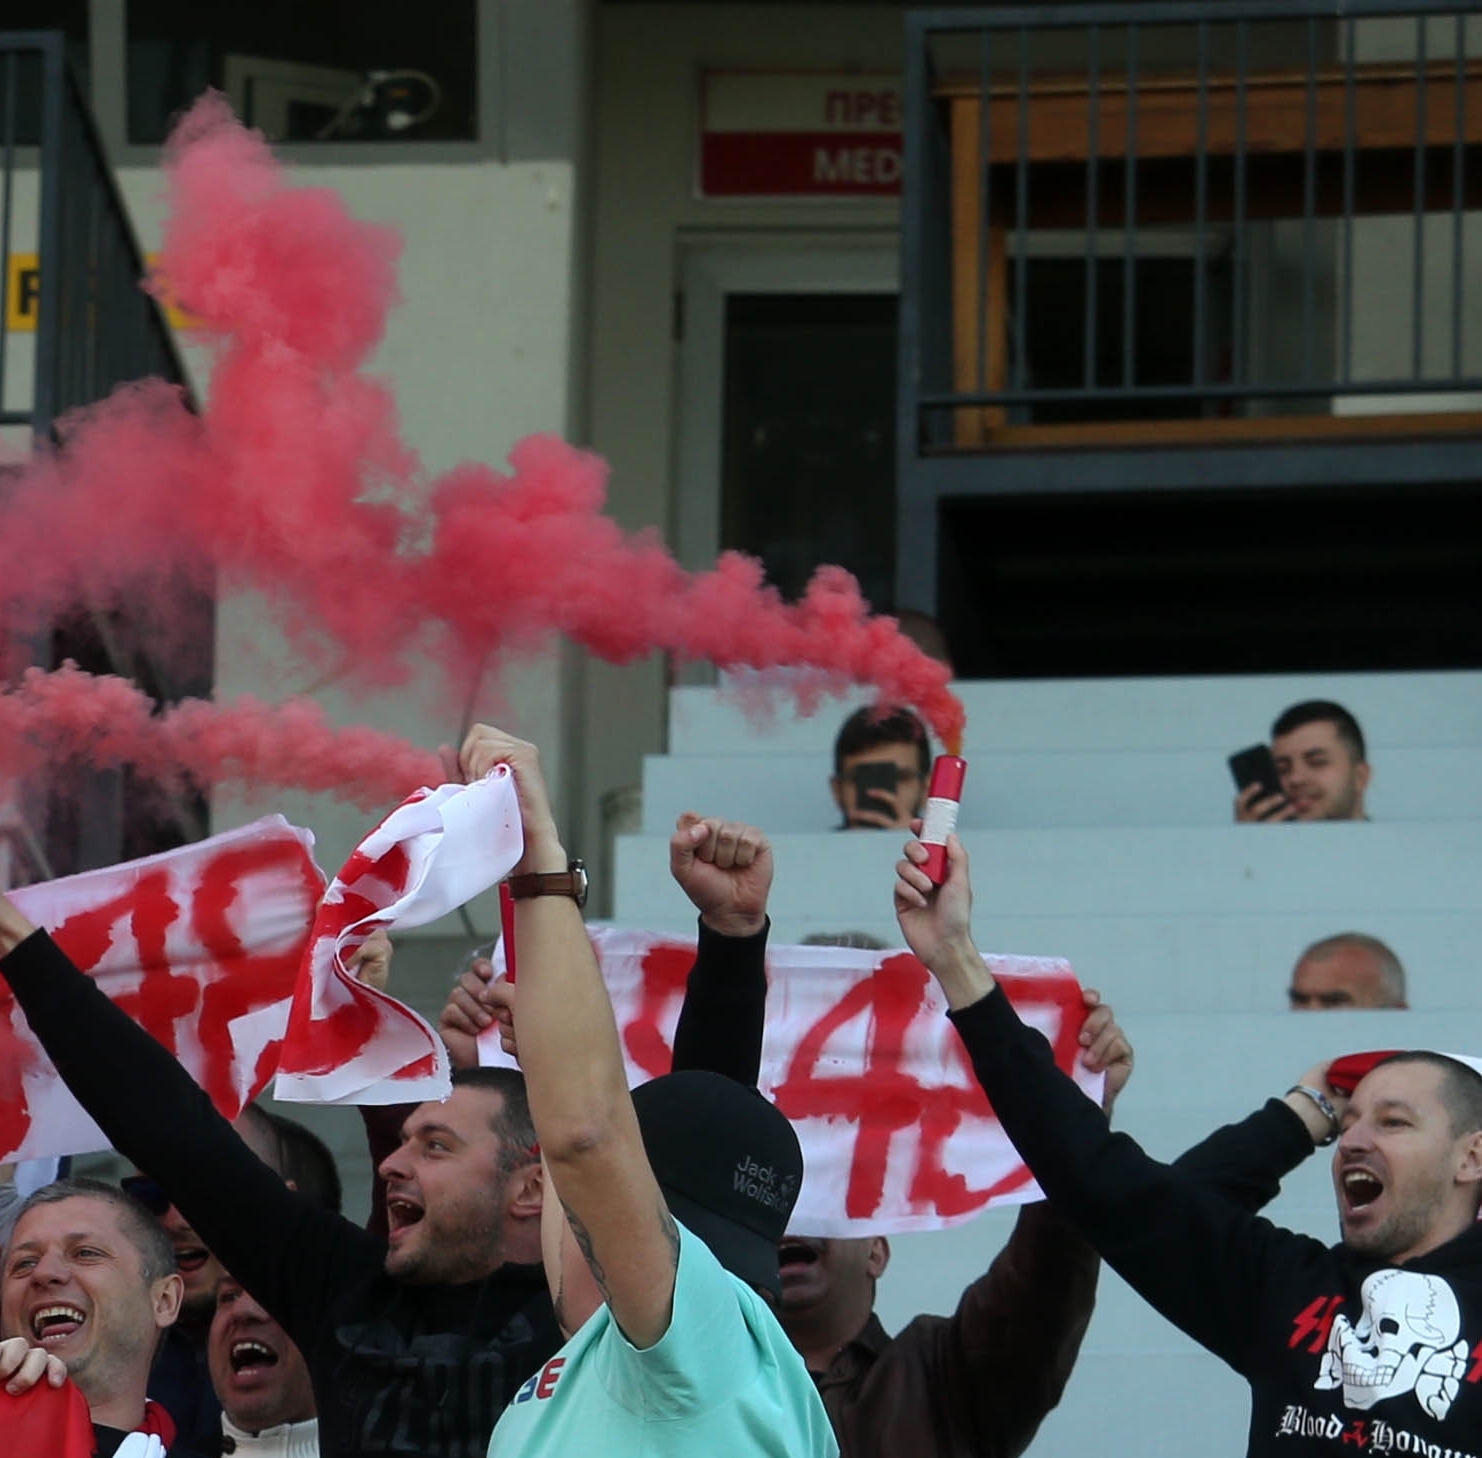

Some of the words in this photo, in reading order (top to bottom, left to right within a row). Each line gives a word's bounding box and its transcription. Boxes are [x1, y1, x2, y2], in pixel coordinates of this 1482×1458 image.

[825, 91, 899, 125] ПРЕ
[813, 149, 900, 184] MED
[737, 1155, 777, 1186] Jack
[1276, 1405, 1343, 1439] Blood
